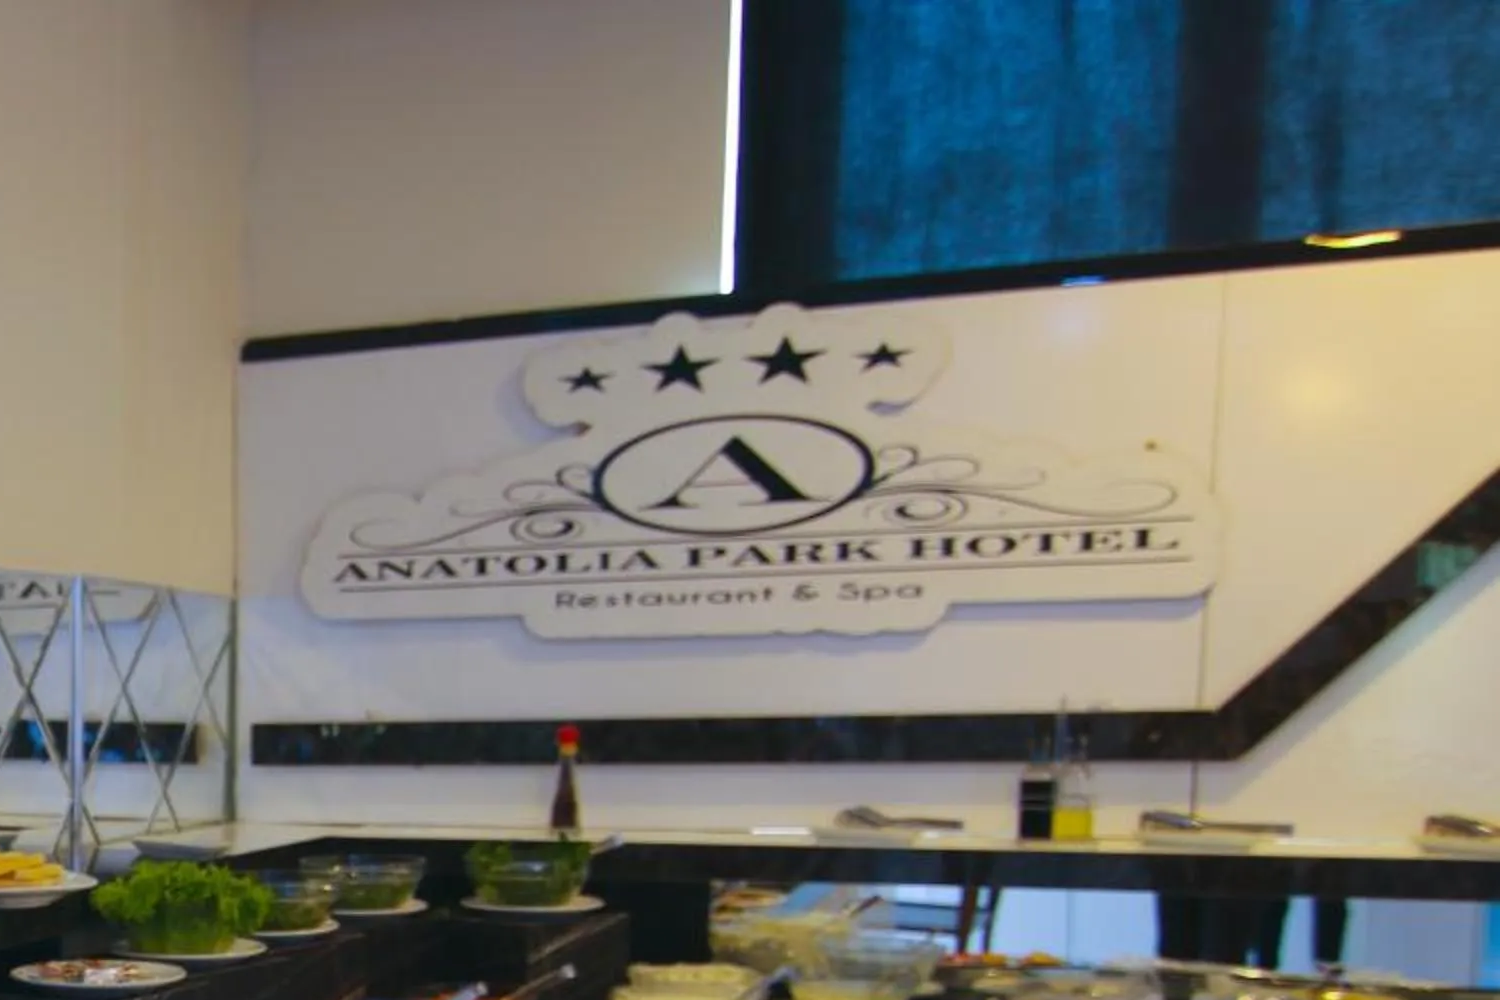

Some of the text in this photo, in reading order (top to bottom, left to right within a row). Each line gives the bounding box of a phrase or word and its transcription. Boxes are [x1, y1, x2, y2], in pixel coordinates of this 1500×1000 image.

[637, 436, 832, 509] A
[334, 528, 1180, 583] ANATOLIA PARK HOTEL
[555, 581, 924, 609] Restaurant & Spa
